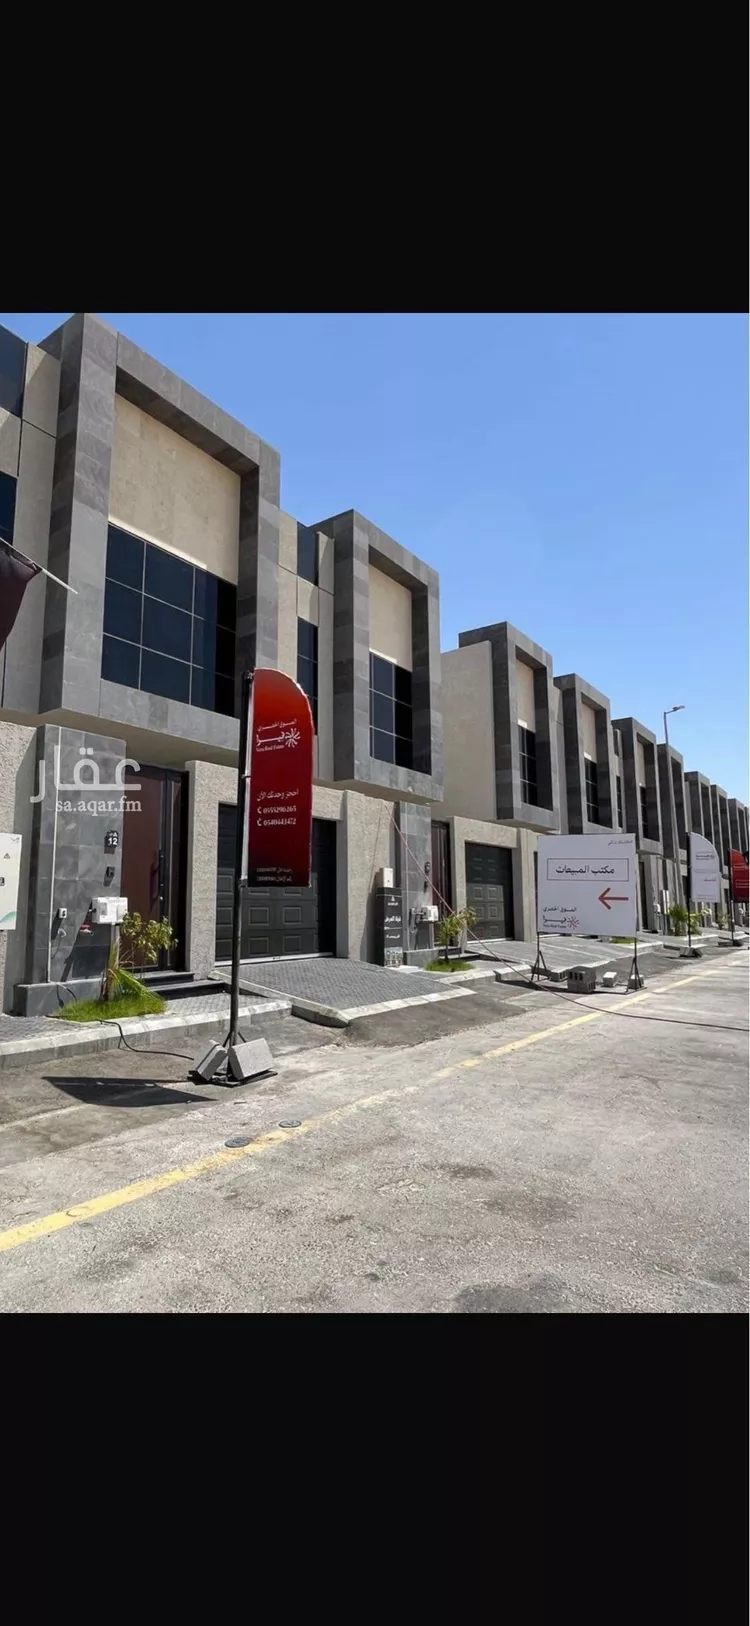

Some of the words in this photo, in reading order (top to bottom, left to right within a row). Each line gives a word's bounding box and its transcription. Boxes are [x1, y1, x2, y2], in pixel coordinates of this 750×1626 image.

[108, 837, 118, 845] 12
[555, 865, 589, 876] المبيعات
[590, 865, 615, 876] مكتب
